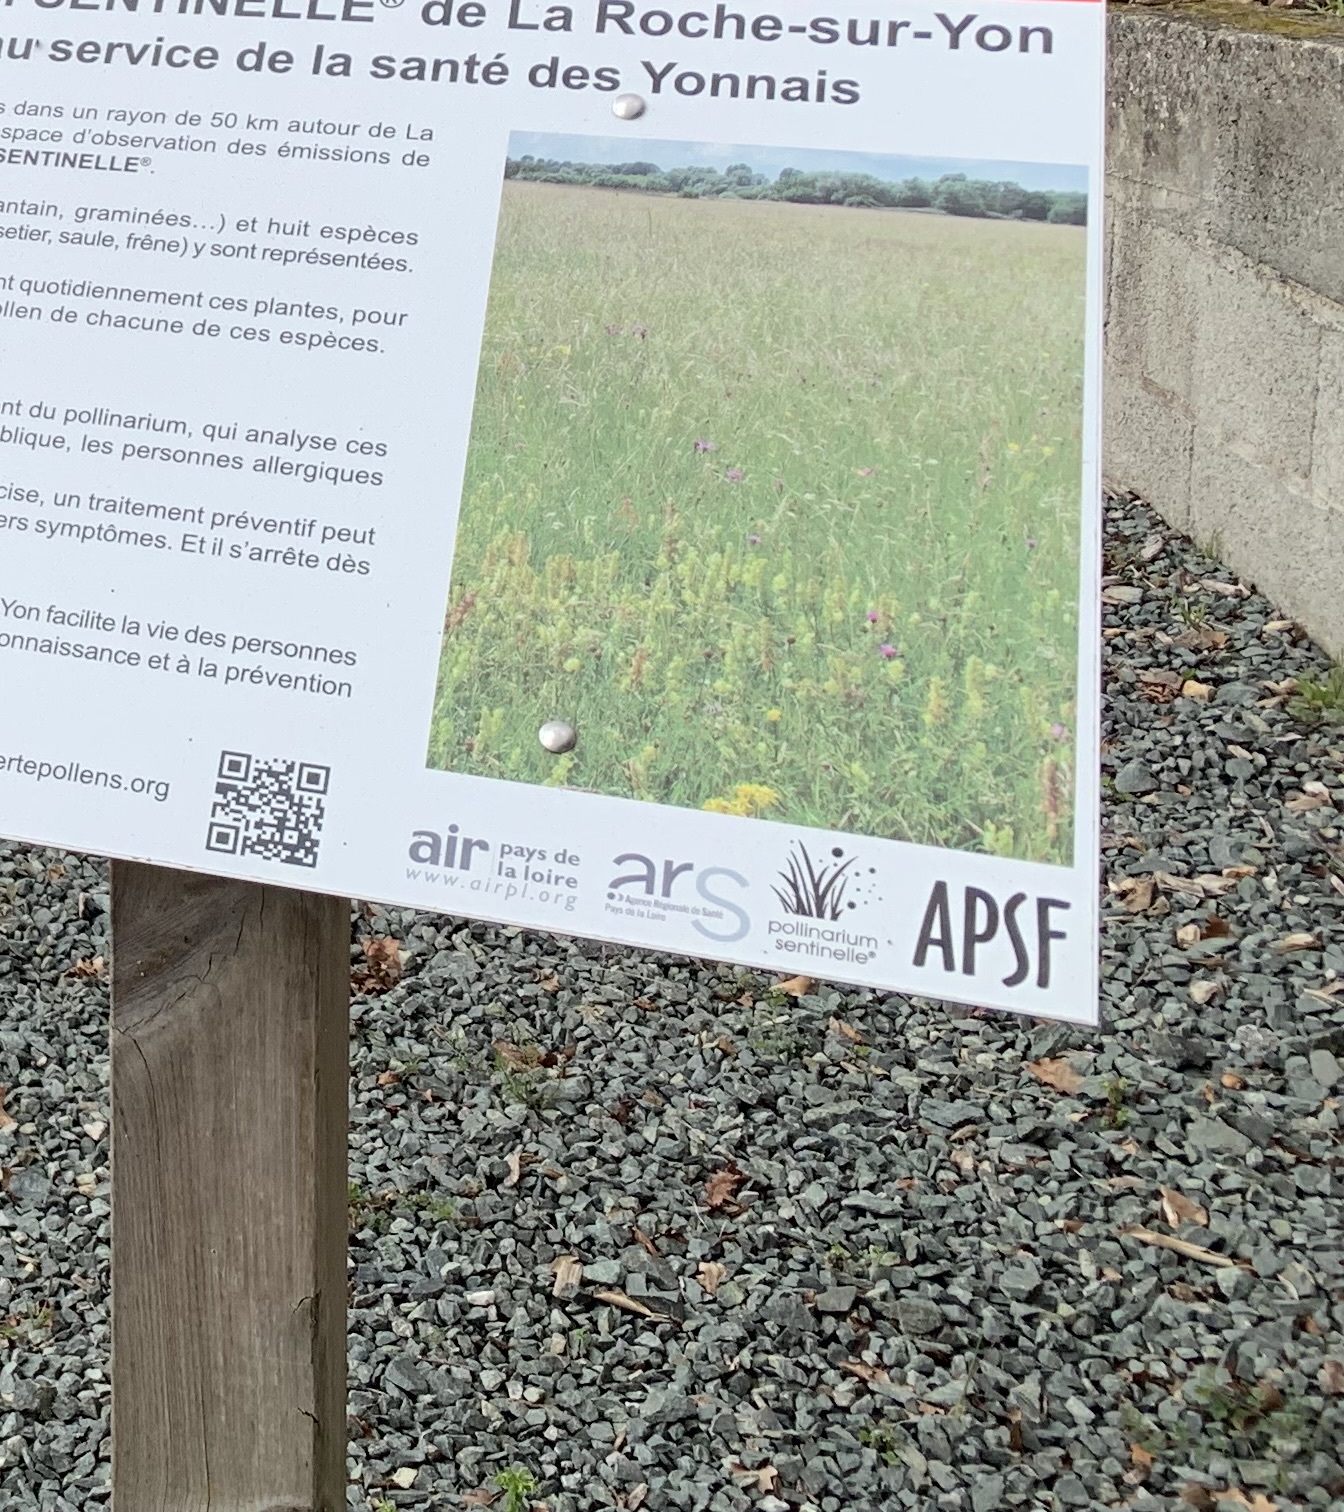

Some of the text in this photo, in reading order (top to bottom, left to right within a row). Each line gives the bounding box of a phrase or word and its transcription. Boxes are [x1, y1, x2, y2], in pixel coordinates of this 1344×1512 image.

[47, 36, 220, 70] service
[235, 41, 295, 74] de
[311, 43, 353, 78] la
[368, 52, 510, 86] santé
[527, 56, 621, 92] des
[640, 60, 860, 105] Yonnais
[13, 100, 64, 118] dans
[72, 107, 98, 121] un
[106, 109, 167, 127] rayon
[174, 109, 202, 127] de
[210, 112, 238, 129] 50
[245, 113, 279, 132] km
[287, 118, 361, 137] autour
[368, 121, 397, 139] de
[406, 123, 434, 142] La
[19, 279, 204, 308] quotidiennement
[208, 296, 249, 312] ces
[253, 297, 344, 324] plantes,
[351, 309, 409, 327] pour
[28, 401, 57, 420] du
[62, 406, 192, 439] pollinarium,
[202, 422, 238, 443] qui
[244, 428, 338, 453] analyse
[345, 438, 388, 458] ces
[46, 604, 116, 632] facilite
[121, 615, 141, 636] la
[147, 620, 179, 642] vie
[184, 625, 227, 648] des
[231, 635, 357, 667] personnes
[408, 823, 490, 872] air
[499, 841, 581, 866] pays de
[405, 867, 579, 912] www.airpl.org
[497, 861, 579, 889] la loire
[768, 919, 878, 949] pollinarium
[912, 880, 1071, 990] APSF
